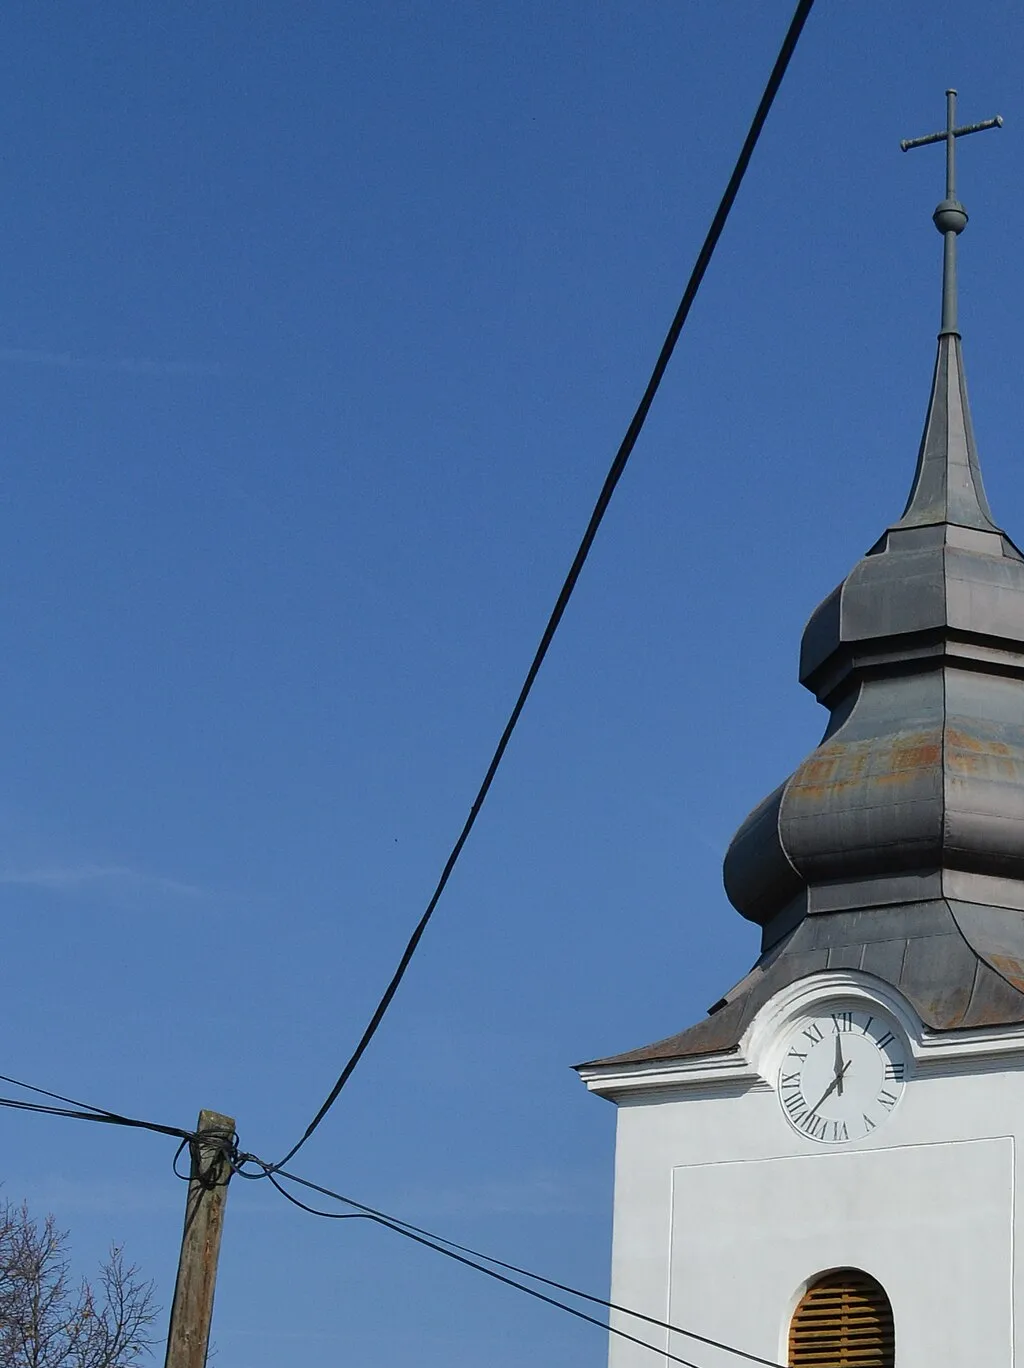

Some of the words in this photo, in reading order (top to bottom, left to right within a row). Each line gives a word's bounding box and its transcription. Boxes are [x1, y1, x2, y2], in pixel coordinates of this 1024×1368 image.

[831, 1012, 853, 1033] XII
[862, 1016, 874, 1036] I
[802, 1023, 824, 1047] XI
[875, 1031, 896, 1051] II
[787, 1046, 808, 1063] X
[782, 1072, 801, 1089] IX
[885, 1063, 904, 1080] III
[784, 1091, 809, 1123] VIII
[877, 1090, 898, 1112] IV
[832, 1121, 849, 1141] VI
[862, 1113, 876, 1132] V
